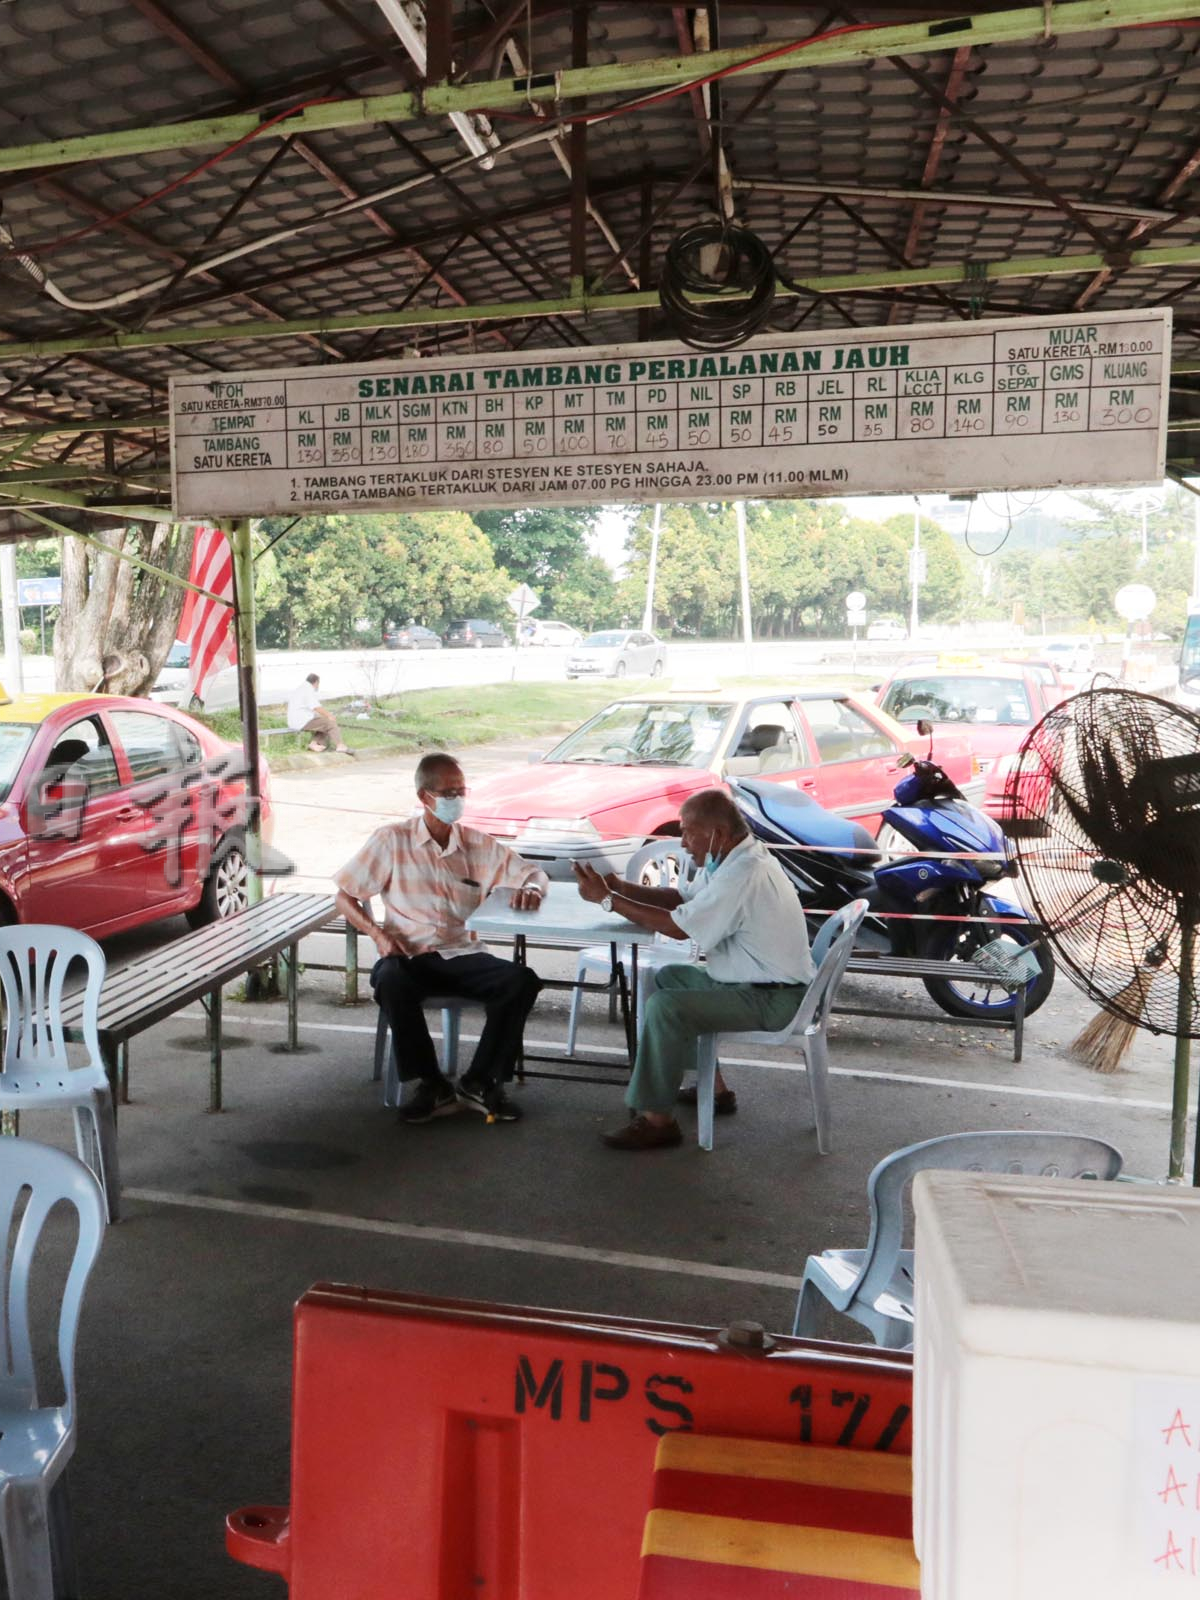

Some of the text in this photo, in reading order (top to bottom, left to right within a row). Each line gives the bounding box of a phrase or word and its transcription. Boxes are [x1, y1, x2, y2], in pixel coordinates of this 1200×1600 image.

[1049, 327, 1098, 345] MUAR
[1008, 347, 1040, 360] SATU
[358, 345, 910, 398] SENARAI TAMBANG PERJALANAN JAUH
[998, 376, 1040, 390] SEPAT
[212, 361, 1148, 432] TEMPAT KL JB MLK SGM KTN BH KP MT TM PD NIL SP RB JEL RL KLIA KLG TG. GMS KLUANG
[904, 382, 942, 396] LCCT
[181, 400, 203, 412] SATU
[203, 390, 1134, 452] TAMBANG RM RM RM RM RM RM RM RM RM RM RM RM RM RM RM RM RM RM RM RM
[483, 440, 503, 455] 80
[523, 438, 548, 453] 50
[560, 436, 589, 453] 100
[608, 434, 627, 449] 70
[646, 432, 669, 449] 45
[688, 429, 711, 446] 50
[730, 429, 752, 443] 50
[768, 426, 793, 441] 45
[818, 424, 838, 436] 50
[864, 423, 883, 437] 35
[910, 418, 935, 432] 80
[953, 418, 985, 432] 140
[1004, 414, 1029, 428] 90
[1052, 411, 1081, 424] 130
[1101, 407, 1152, 425] 300
[194, 452, 272, 469] SATU KERETA
[304, 475, 366, 488] TAMBANG
[370, 471, 447, 485] TERTAKLUK
[452, 469, 483, 480] DARI
[487, 466, 549, 479] STESYEN
[554, 465, 572, 476] KE
[577, 463, 642, 476] STESYEN
[646, 461, 708, 474] SAHAJA.
[304, 489, 349, 501] HARGA
[353, 486, 416, 499] TAMBANG
[420, 482, 497, 496] TERTAKLUK
[503, 481, 535, 493] DARI
[539, 480, 568, 491] JAM
[572, 478, 606, 490] 07.00
[611, 477, 631, 488] PG
[635, 475, 692, 488] HINGGA
[696, 474, 732, 486] 23.00
[737, 473, 758, 484] PM
[763, 471, 804, 484] (11.00
[809, 469, 849, 482] MLM)
[515, 1355, 695, 1437] MPS
